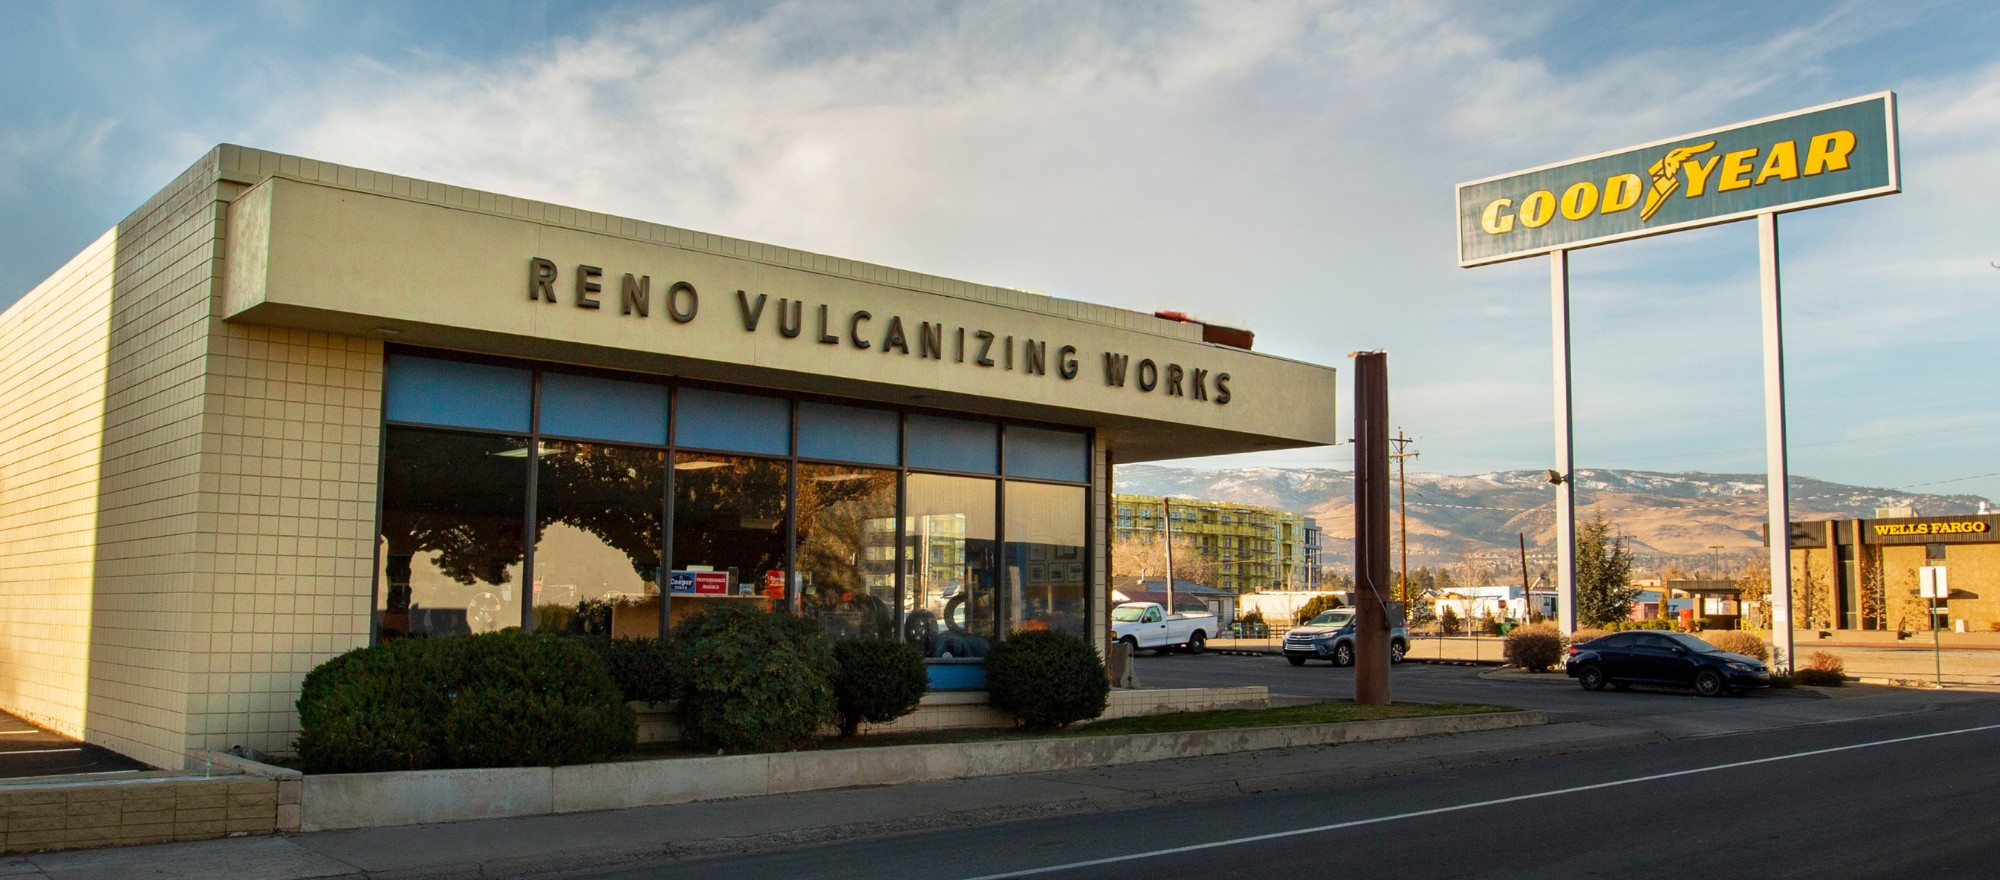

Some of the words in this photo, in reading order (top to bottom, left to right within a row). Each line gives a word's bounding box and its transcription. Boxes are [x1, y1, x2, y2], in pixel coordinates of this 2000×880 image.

[529, 257, 699, 323] RENO
[737, 290, 1079, 380] VULCANIZING
[1105, 351, 1232, 405] WORKS
[1874, 523, 1928, 535] WELLS
[1930, 521, 1985, 533] FARGO
[671, 578, 692, 586] Cooper
